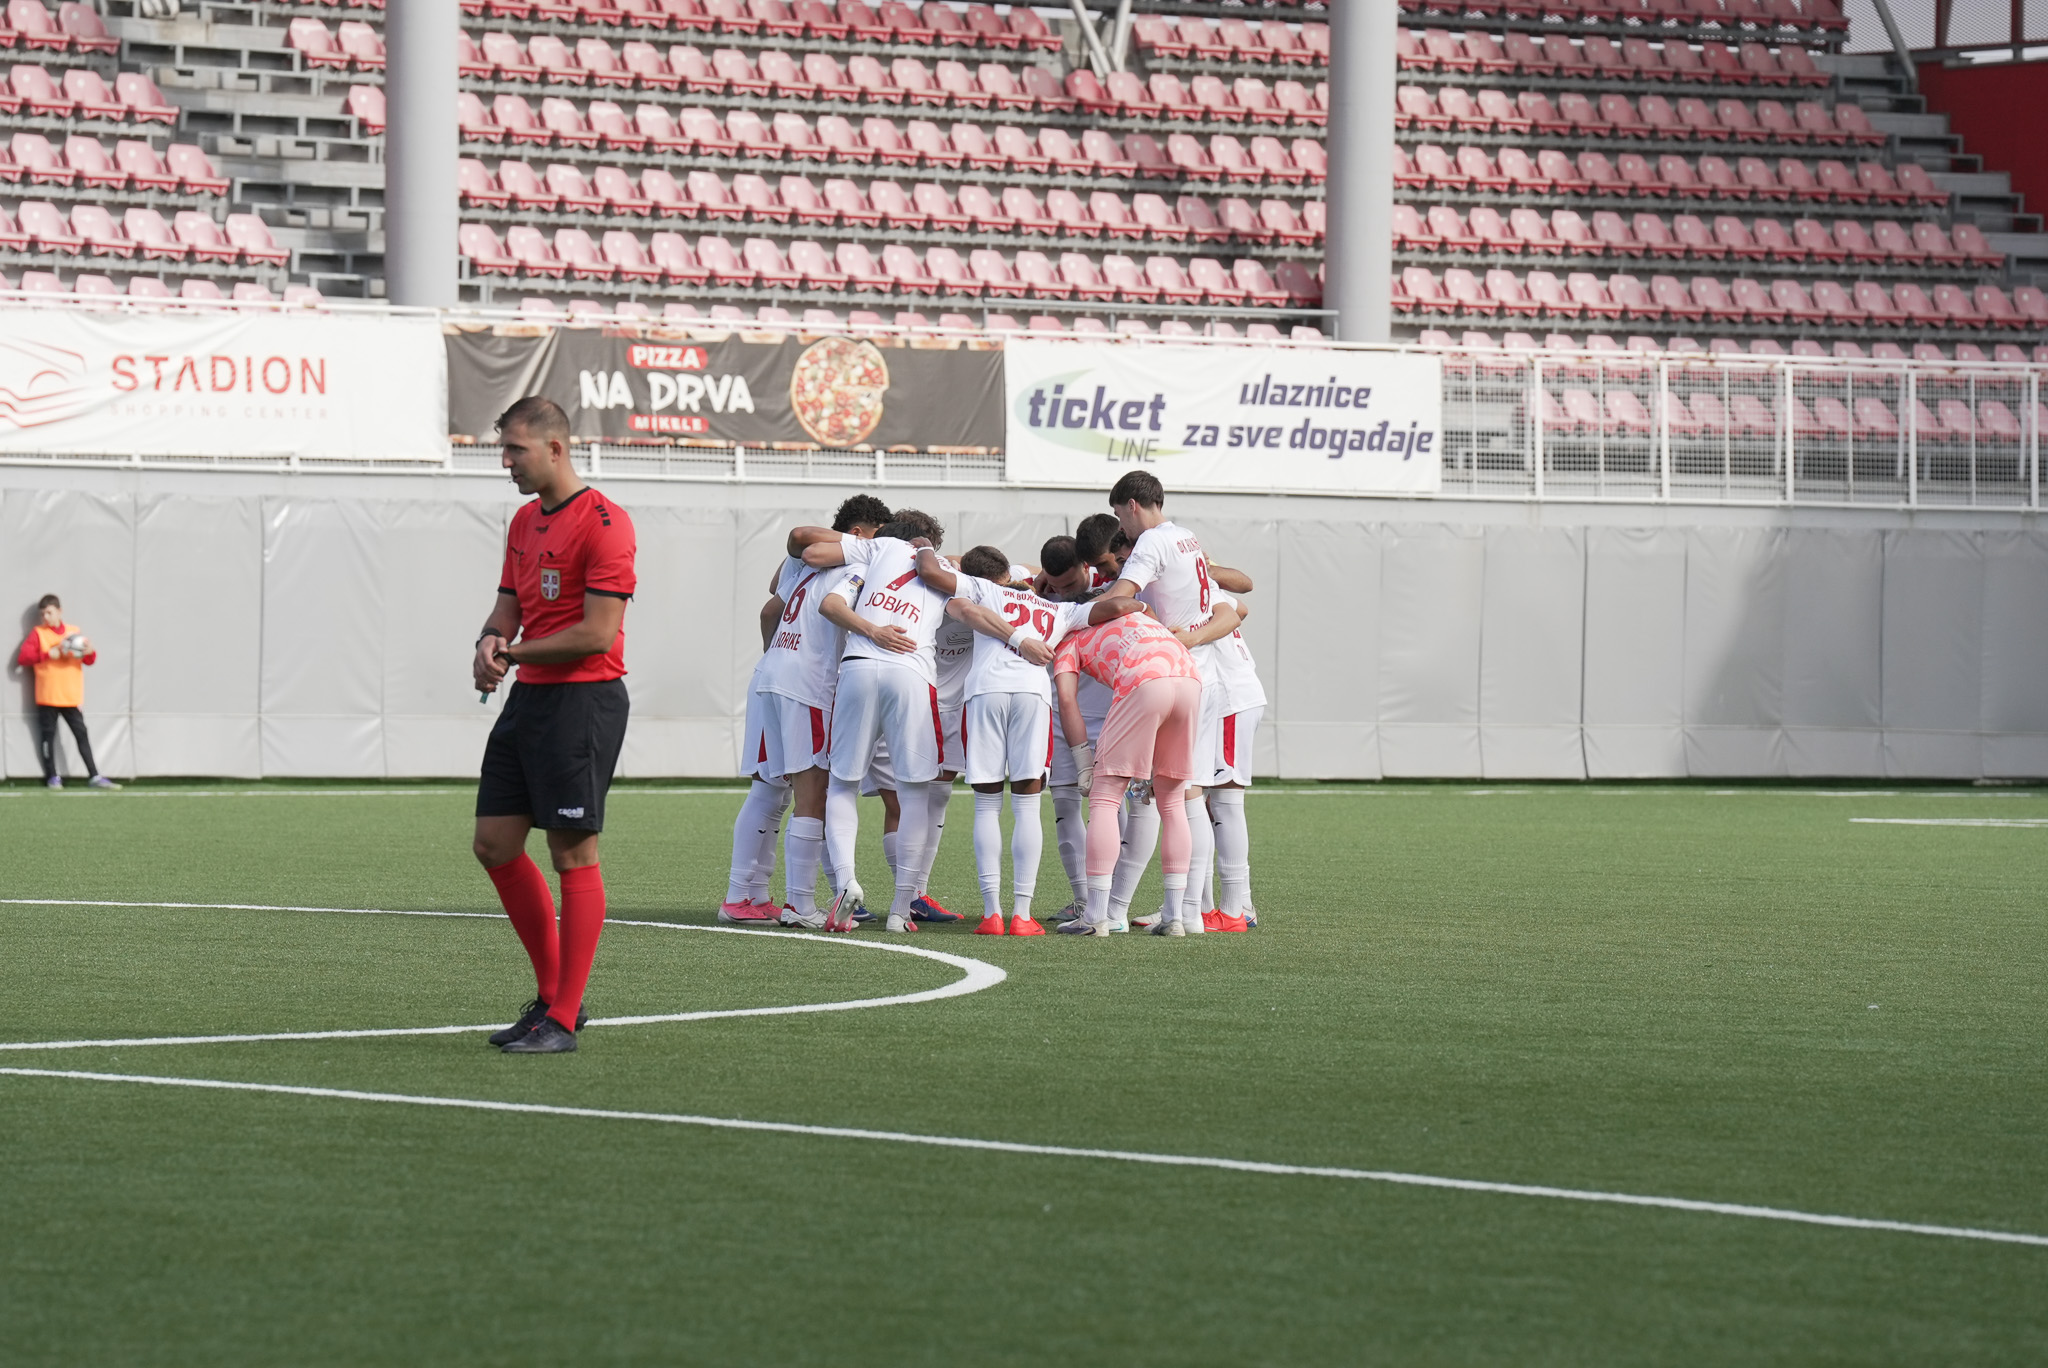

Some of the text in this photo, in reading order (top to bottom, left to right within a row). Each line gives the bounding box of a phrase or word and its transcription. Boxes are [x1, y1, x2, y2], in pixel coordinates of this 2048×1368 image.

[111, 354, 327, 395] STADION
[632, 346, 701, 369] PIZZA
[579, 370, 755, 415] NA DRVA
[1028, 384, 1166, 431] ticket
[1239, 373, 1372, 409] ulaznice
[110, 403, 329, 421] SHOPPING CENTER
[634, 415, 704, 433] MIKELE
[1107, 437, 1161, 463] LINE
[1182, 417, 1434, 461] za sve događaje
[782, 571, 818, 625] 6
[1195, 556, 1211, 614] 8
[864, 591, 921, 624] ЈОВИЋ
[1003, 602, 1056, 643] 29
